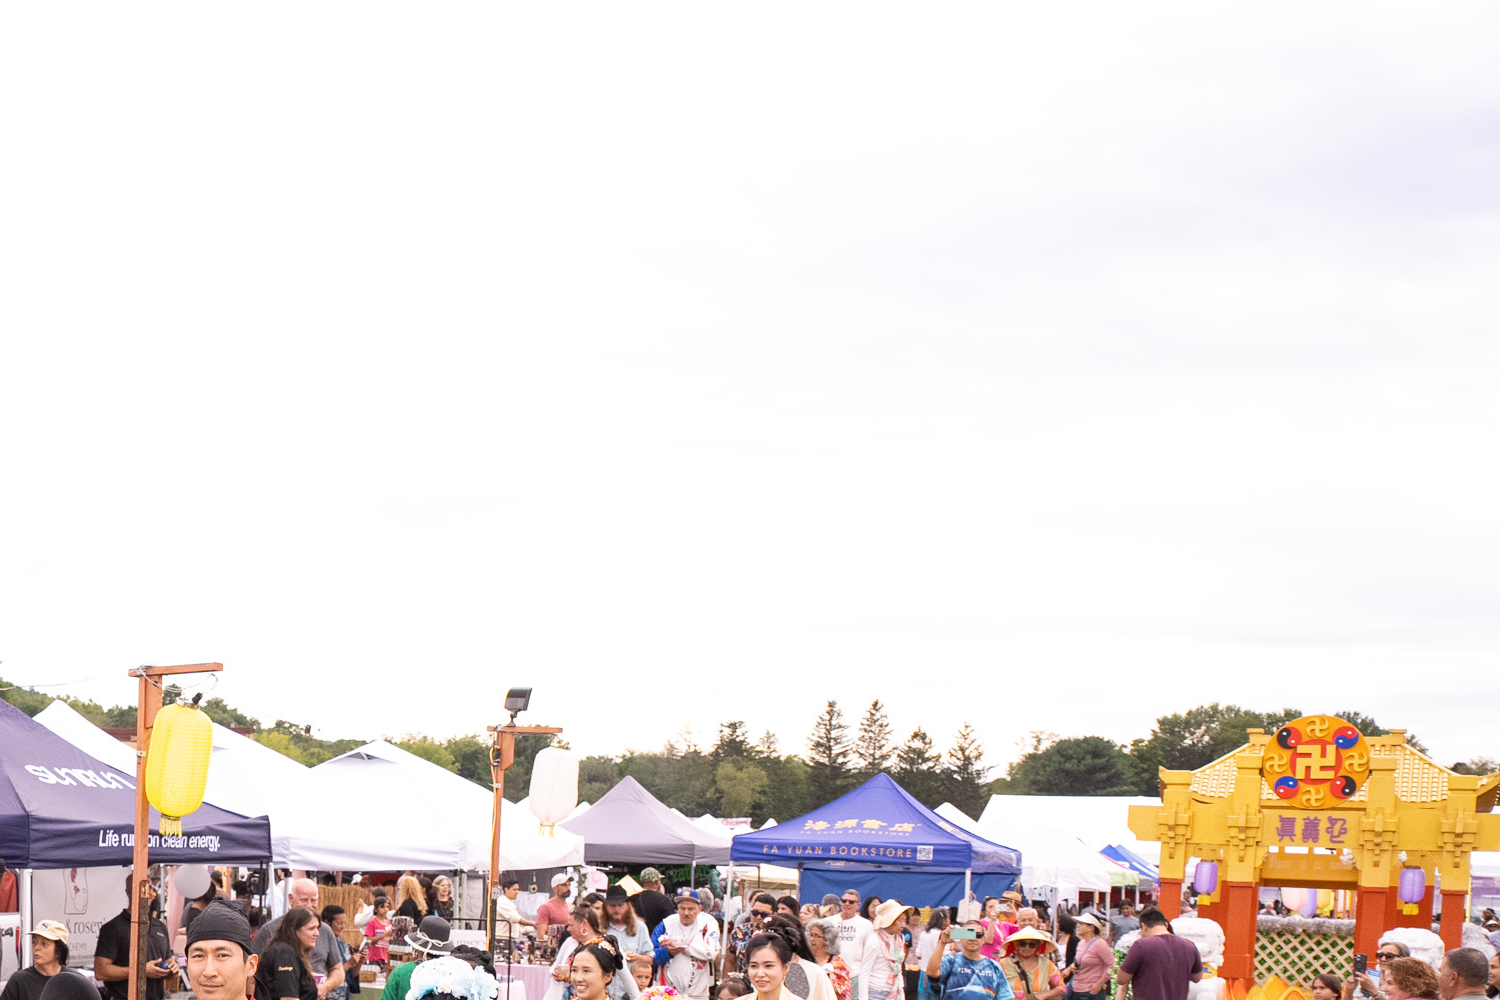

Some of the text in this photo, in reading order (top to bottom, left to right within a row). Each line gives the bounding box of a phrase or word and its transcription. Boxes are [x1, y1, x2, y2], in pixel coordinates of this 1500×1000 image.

[99, 830, 119, 847] Life
[147, 835, 159, 848] on
[161, 833, 187, 848] clean
[189, 835, 220, 852] energy.
[763, 845, 912, 858] FA YUAN BOOKSTORE
